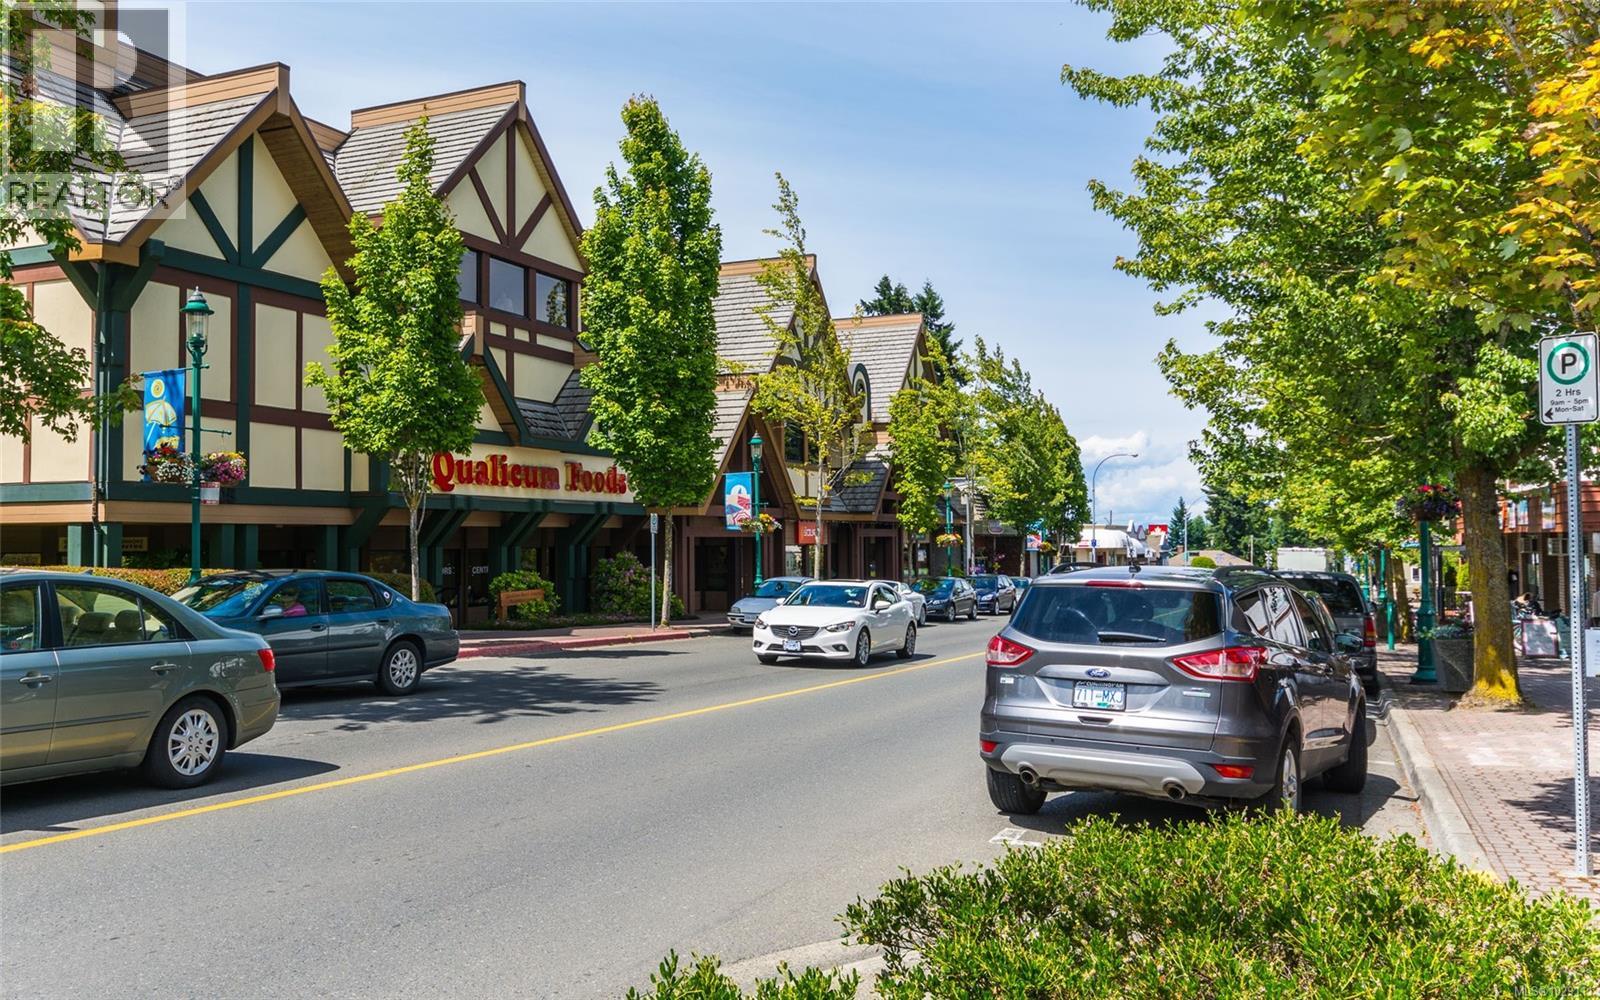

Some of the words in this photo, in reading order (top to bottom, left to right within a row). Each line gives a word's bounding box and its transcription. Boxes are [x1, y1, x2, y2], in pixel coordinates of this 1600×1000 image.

[1561, 352, 1577, 375] P
[1555, 389, 1562, 397] 2
[1565, 388, 1581, 396] Hrs
[1554, 405, 1584, 413] Mon-Sat
[432, 452, 560, 492] Qualicum
[564, 461, 627, 494] Foods
